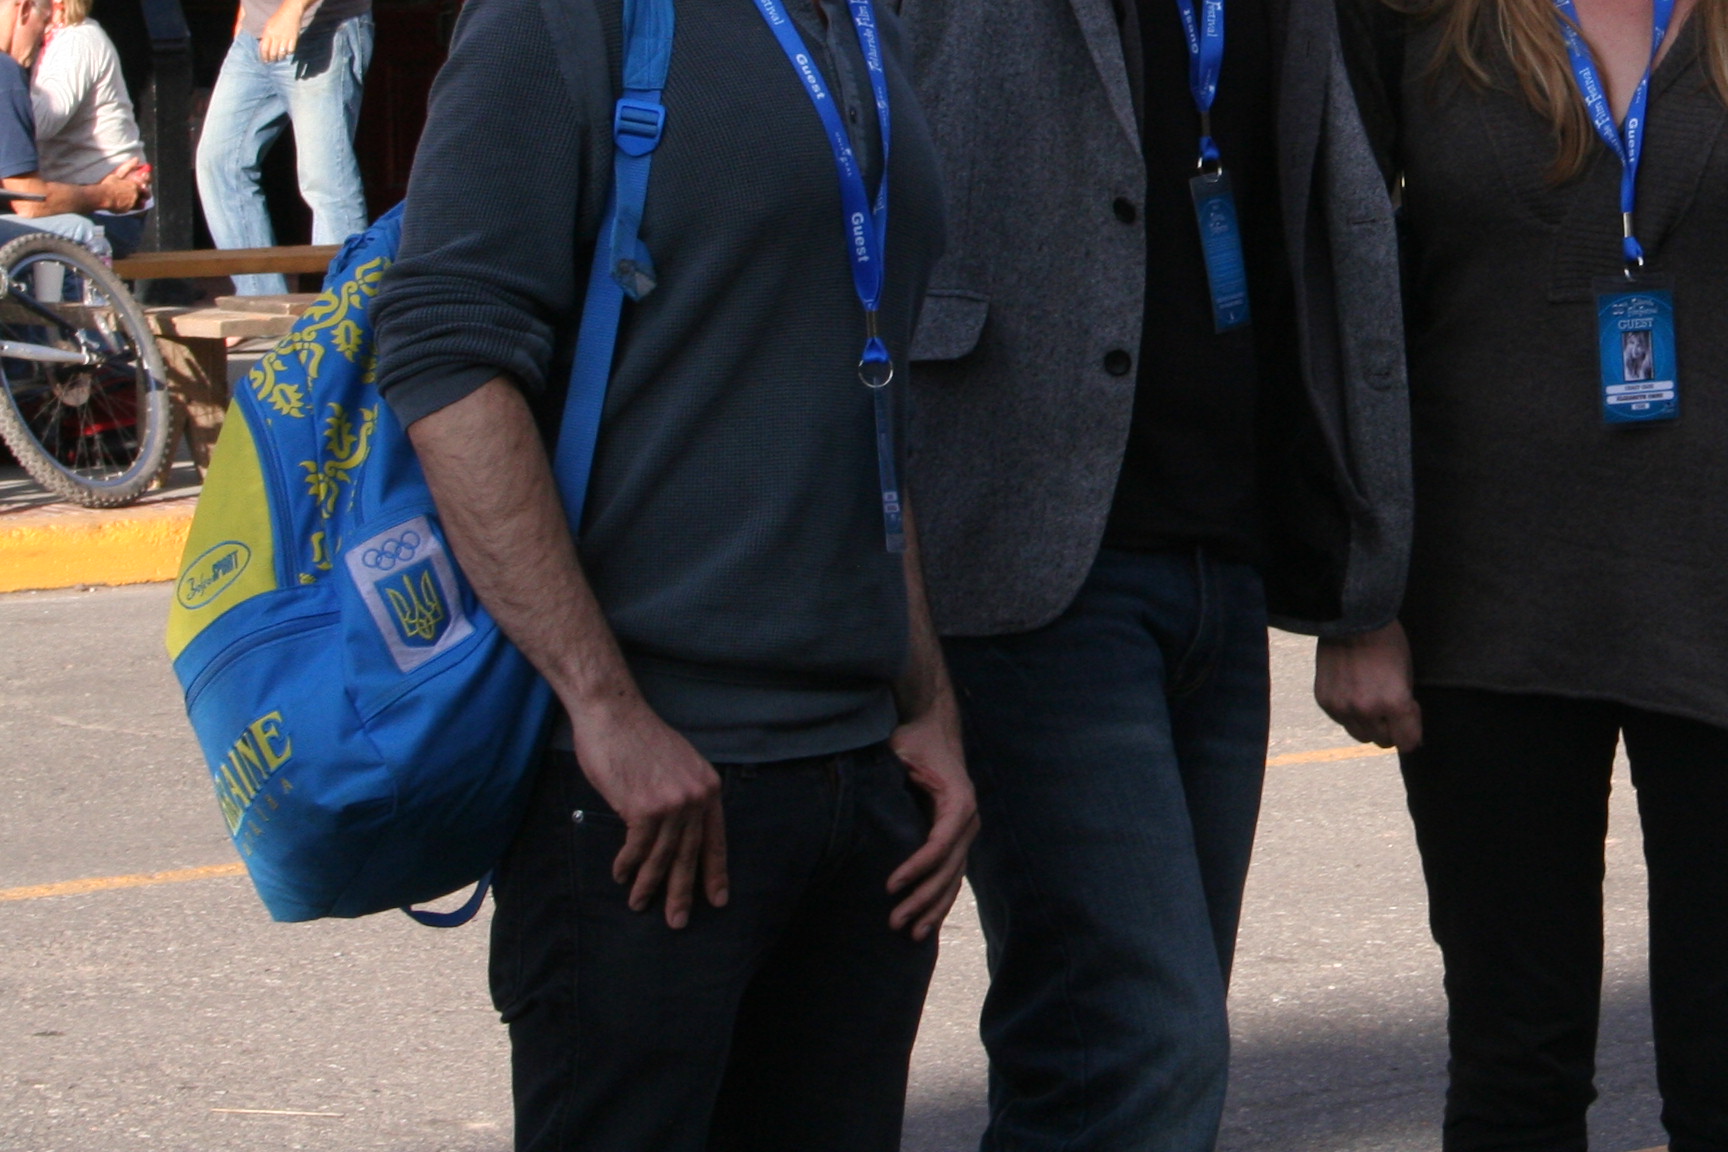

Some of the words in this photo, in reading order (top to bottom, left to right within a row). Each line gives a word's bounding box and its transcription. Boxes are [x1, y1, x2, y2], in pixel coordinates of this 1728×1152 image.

[856, 5, 874, 28] Film
[1206, 0, 1222, 38] Festival
[862, 29, 883, 72] Telluride
[795, 53, 826, 100] Guest
[1578, 66, 1603, 106] Festival
[1627, 117, 1639, 163] Guest
[851, 211, 870, 263] Guest
[1618, 317, 1654, 330] GUEST
